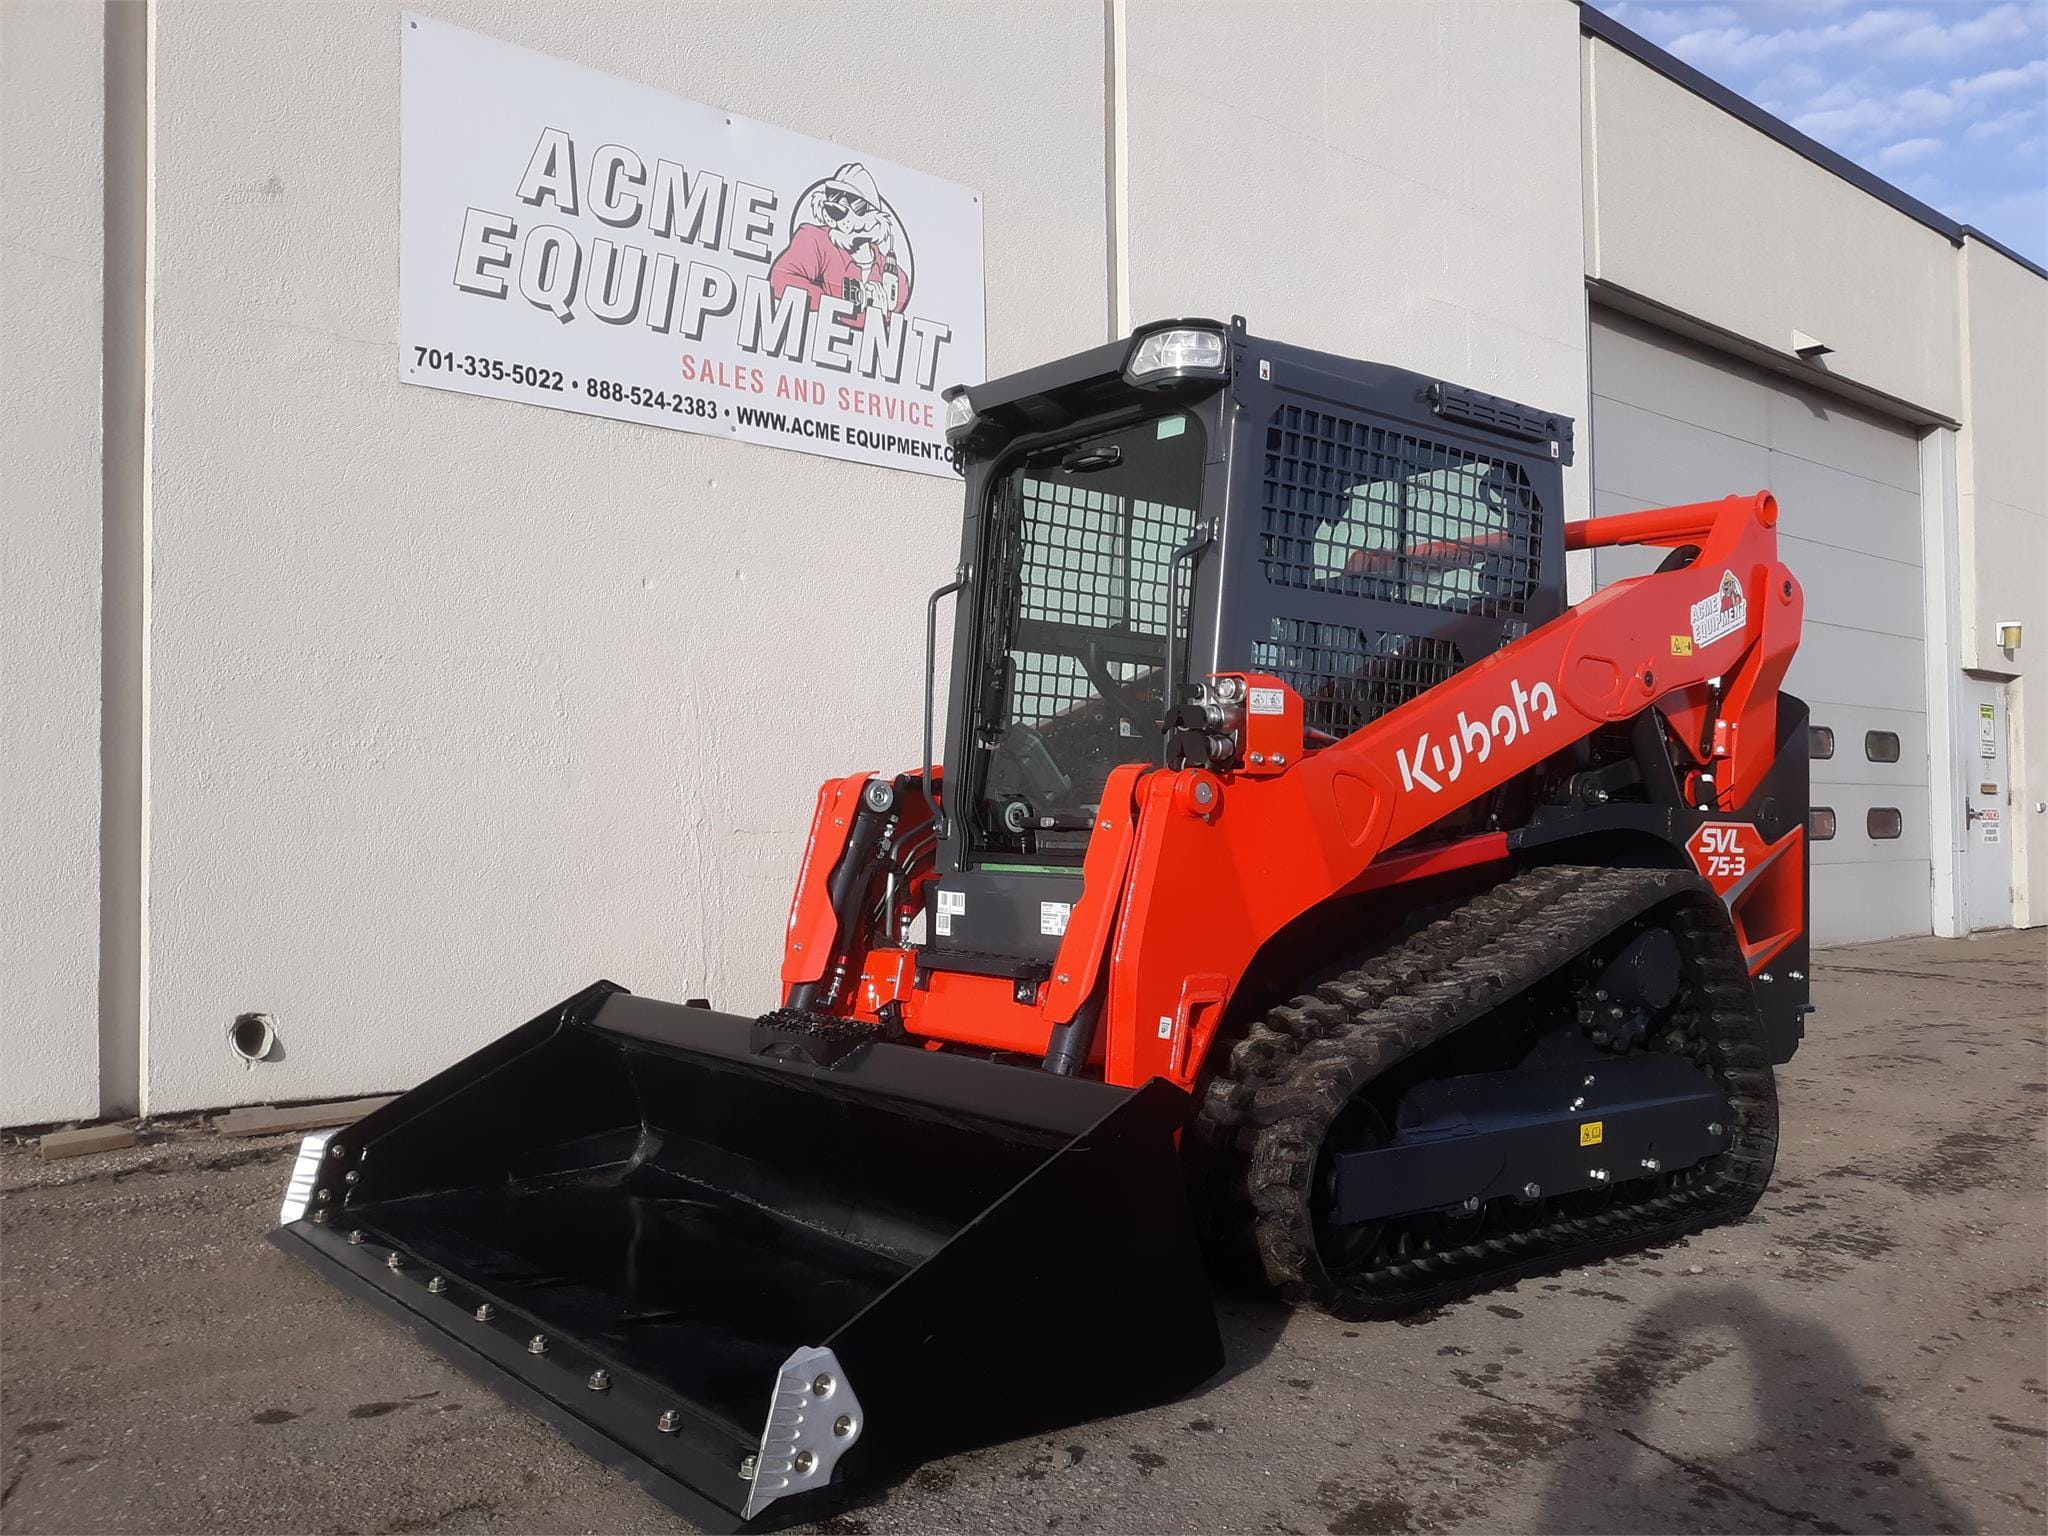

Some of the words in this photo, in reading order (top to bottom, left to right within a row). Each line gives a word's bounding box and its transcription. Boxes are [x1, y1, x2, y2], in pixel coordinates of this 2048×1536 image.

[516, 127, 777, 263] ACME
[453, 207, 951, 391] EQUIPMENT
[414, 346, 564, 392] 701-335-5022
[586, 378, 718, 419] 888-524-2383
[736, 406, 840, 442] WWW.ACME
[681, 354, 764, 394] SALES
[776, 375, 826, 406] AND
[838, 387, 934, 428] SERVICE
[1692, 597, 1718, 624] ACME
[1695, 602, 1746, 641] EQUIPMENT
[1396, 678, 1558, 793] Kubota
[1699, 828, 1745, 854] SVL
[1707, 856, 1746, 876] 75-3
